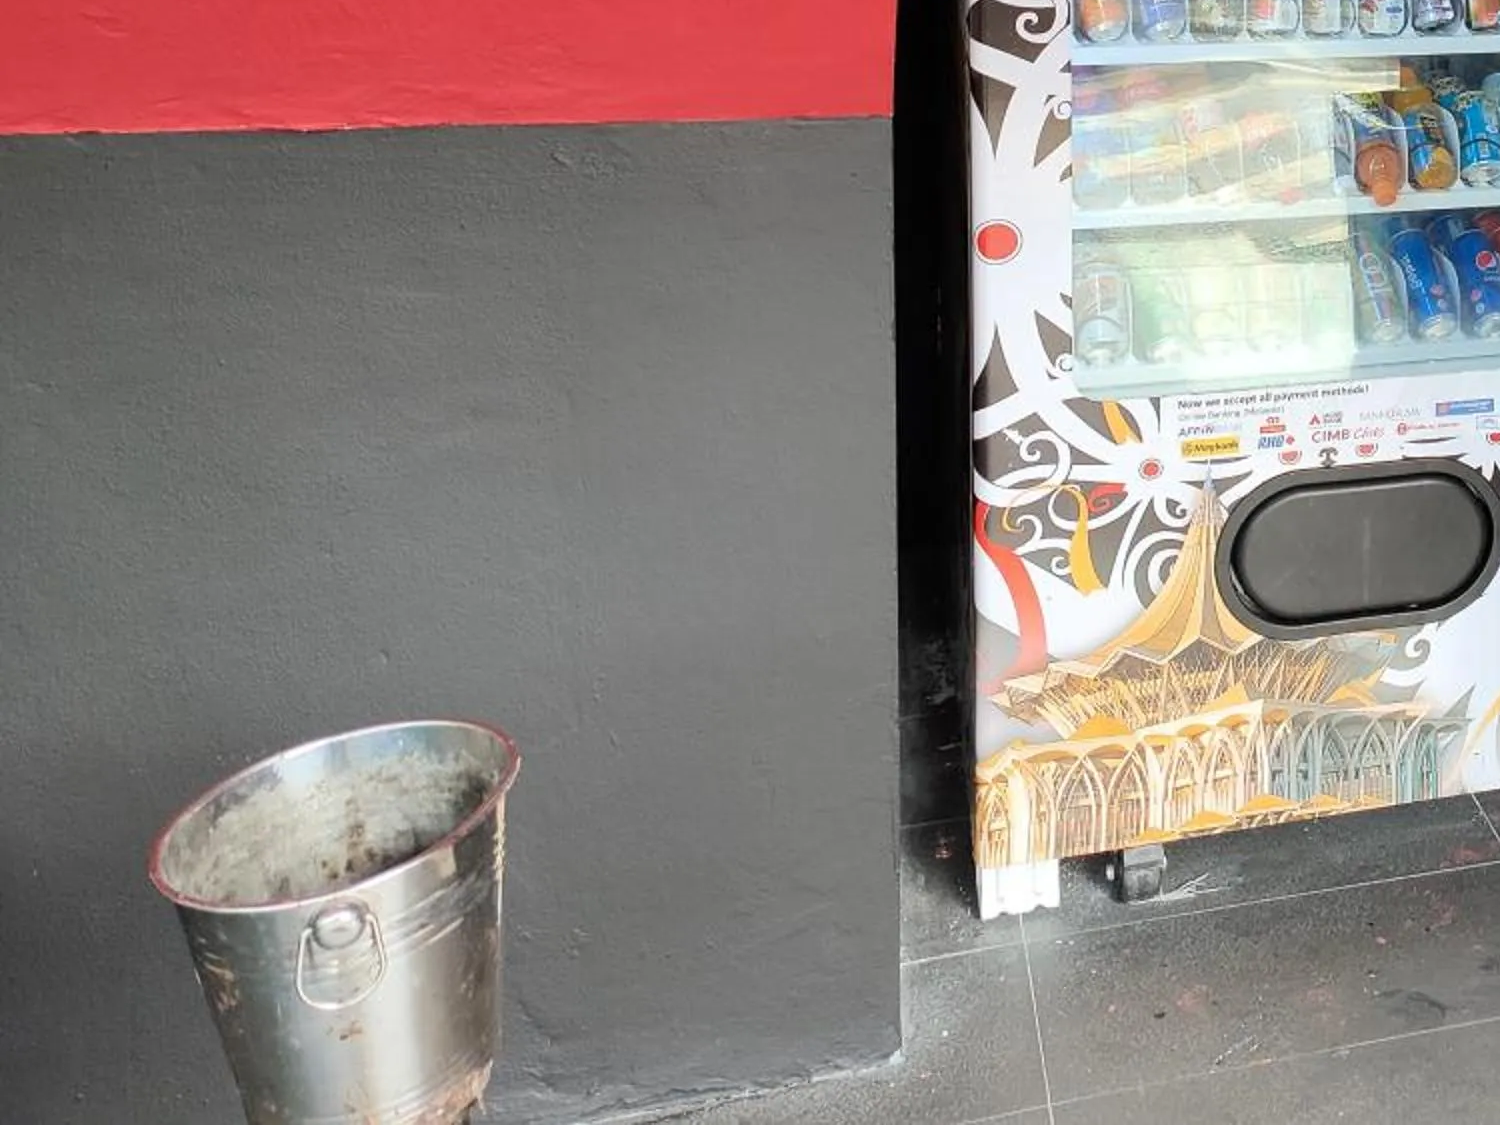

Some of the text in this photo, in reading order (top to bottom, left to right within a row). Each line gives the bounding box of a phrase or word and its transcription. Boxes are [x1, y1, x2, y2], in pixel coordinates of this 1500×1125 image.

[1177, 400, 1202, 409] Now
[1224, 395, 1257, 406] accept
[1259, 392, 1272, 402] all
[1274, 389, 1319, 402] payment
[1258, 435, 1285, 450] RHB
[1311, 429, 1350, 444] CIMB
